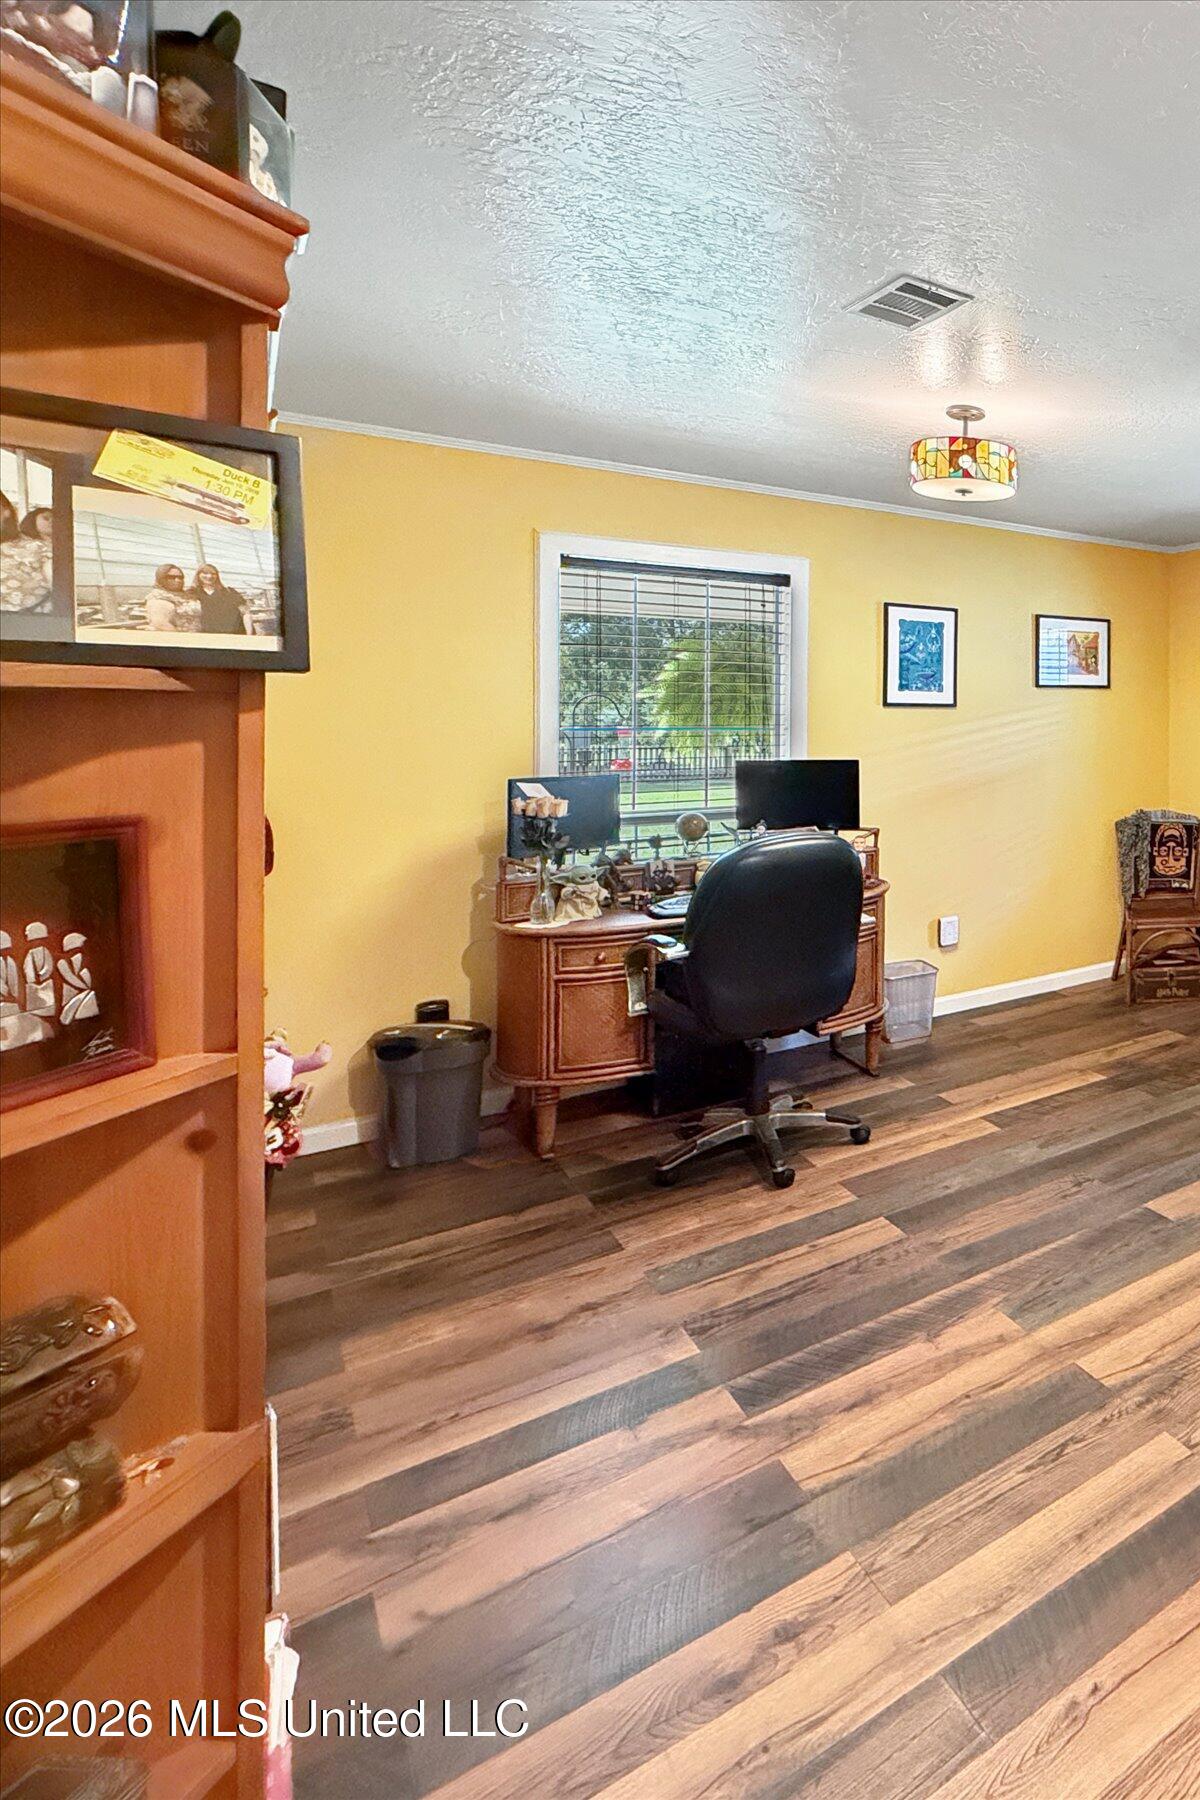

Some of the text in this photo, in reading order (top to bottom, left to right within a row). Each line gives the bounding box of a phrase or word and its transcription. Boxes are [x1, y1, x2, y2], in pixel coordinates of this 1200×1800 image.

[222, 468, 250, 485] Duck
[252, 479, 261, 489] B
[232, 489, 255, 506] PM
